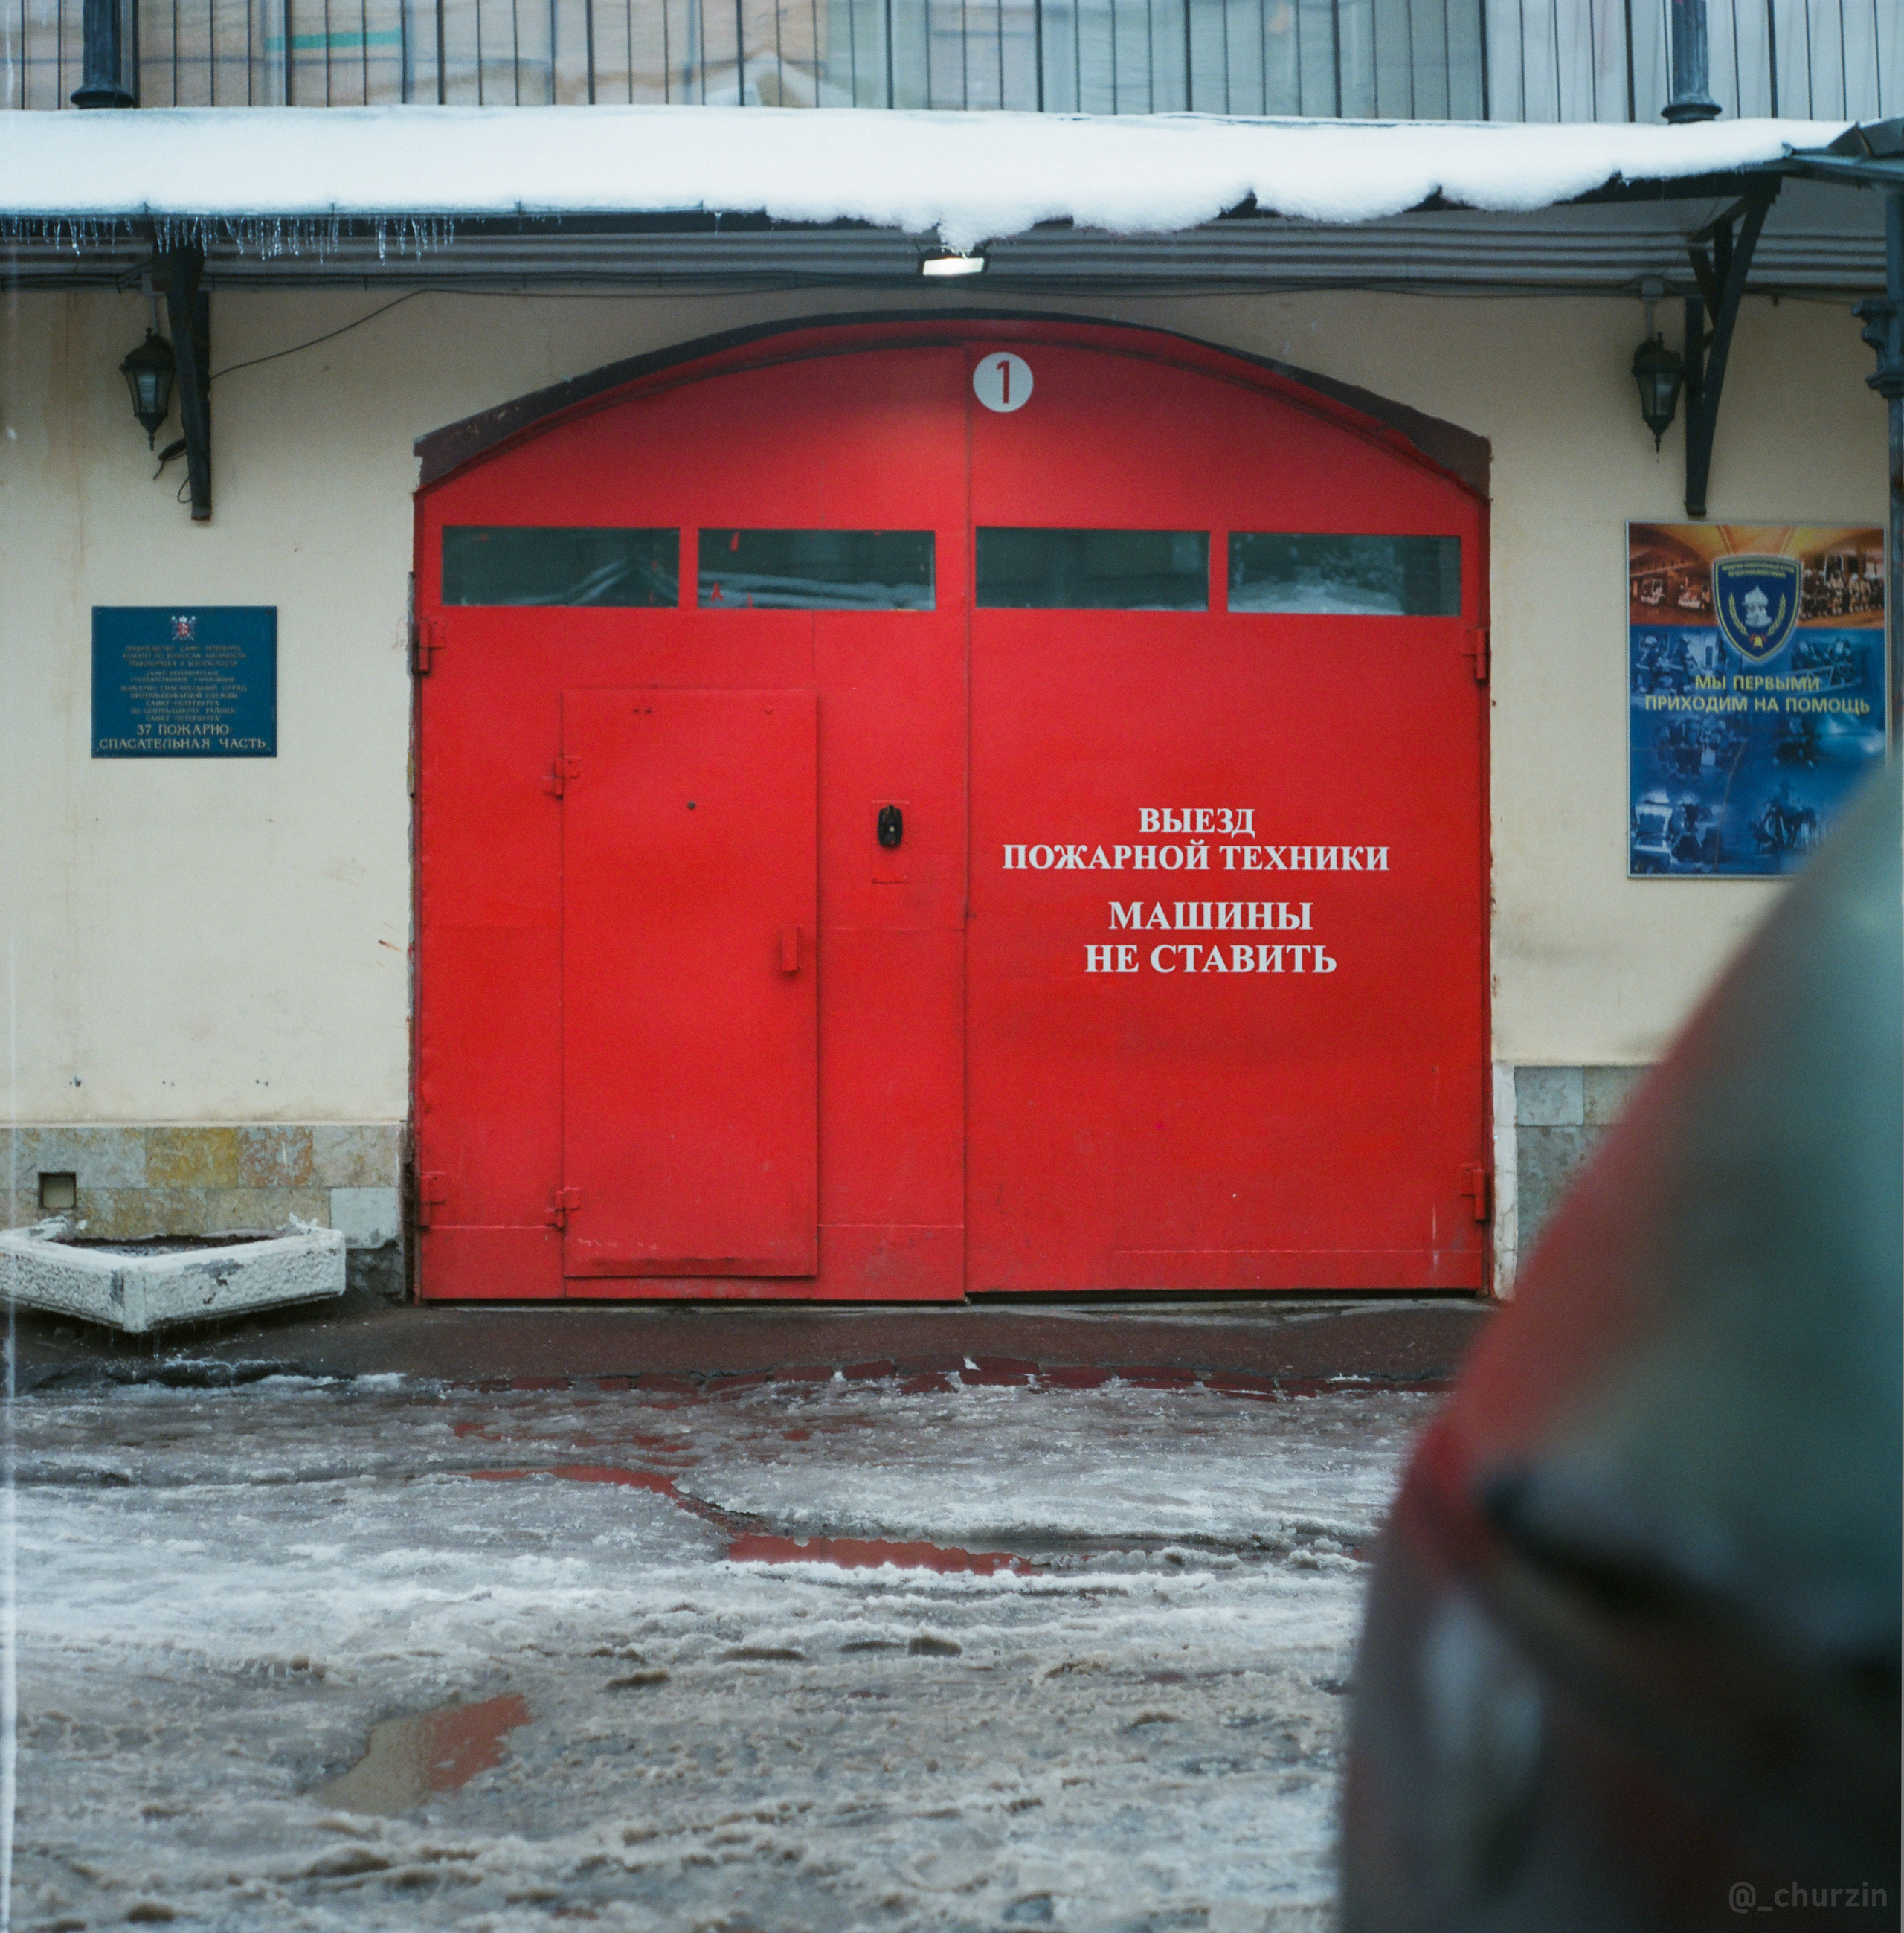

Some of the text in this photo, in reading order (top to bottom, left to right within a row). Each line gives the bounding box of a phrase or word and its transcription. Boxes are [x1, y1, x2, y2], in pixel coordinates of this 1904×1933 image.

[997, 359, 1010, 404] 1
[1695, 675, 1820, 691] МЫ ПЕРВЫМИ
[1645, 696, 1870, 715] ПРИХОДИМ НА ПОМОЩЬ
[99, 738, 266, 749] СПАСАТЕЛЬНАЯ ЧАСТЬ
[137, 724, 152, 735] 37
[1139, 808, 1255, 837] ВЫЕЗД
[1003, 840, 1389, 870] ПОЖАРНОЙ ТЕХНИКИ
[1109, 902, 1313, 930] МАШИНЫ
[1084, 945, 1337, 973] НЕ СТАВИТЬ
